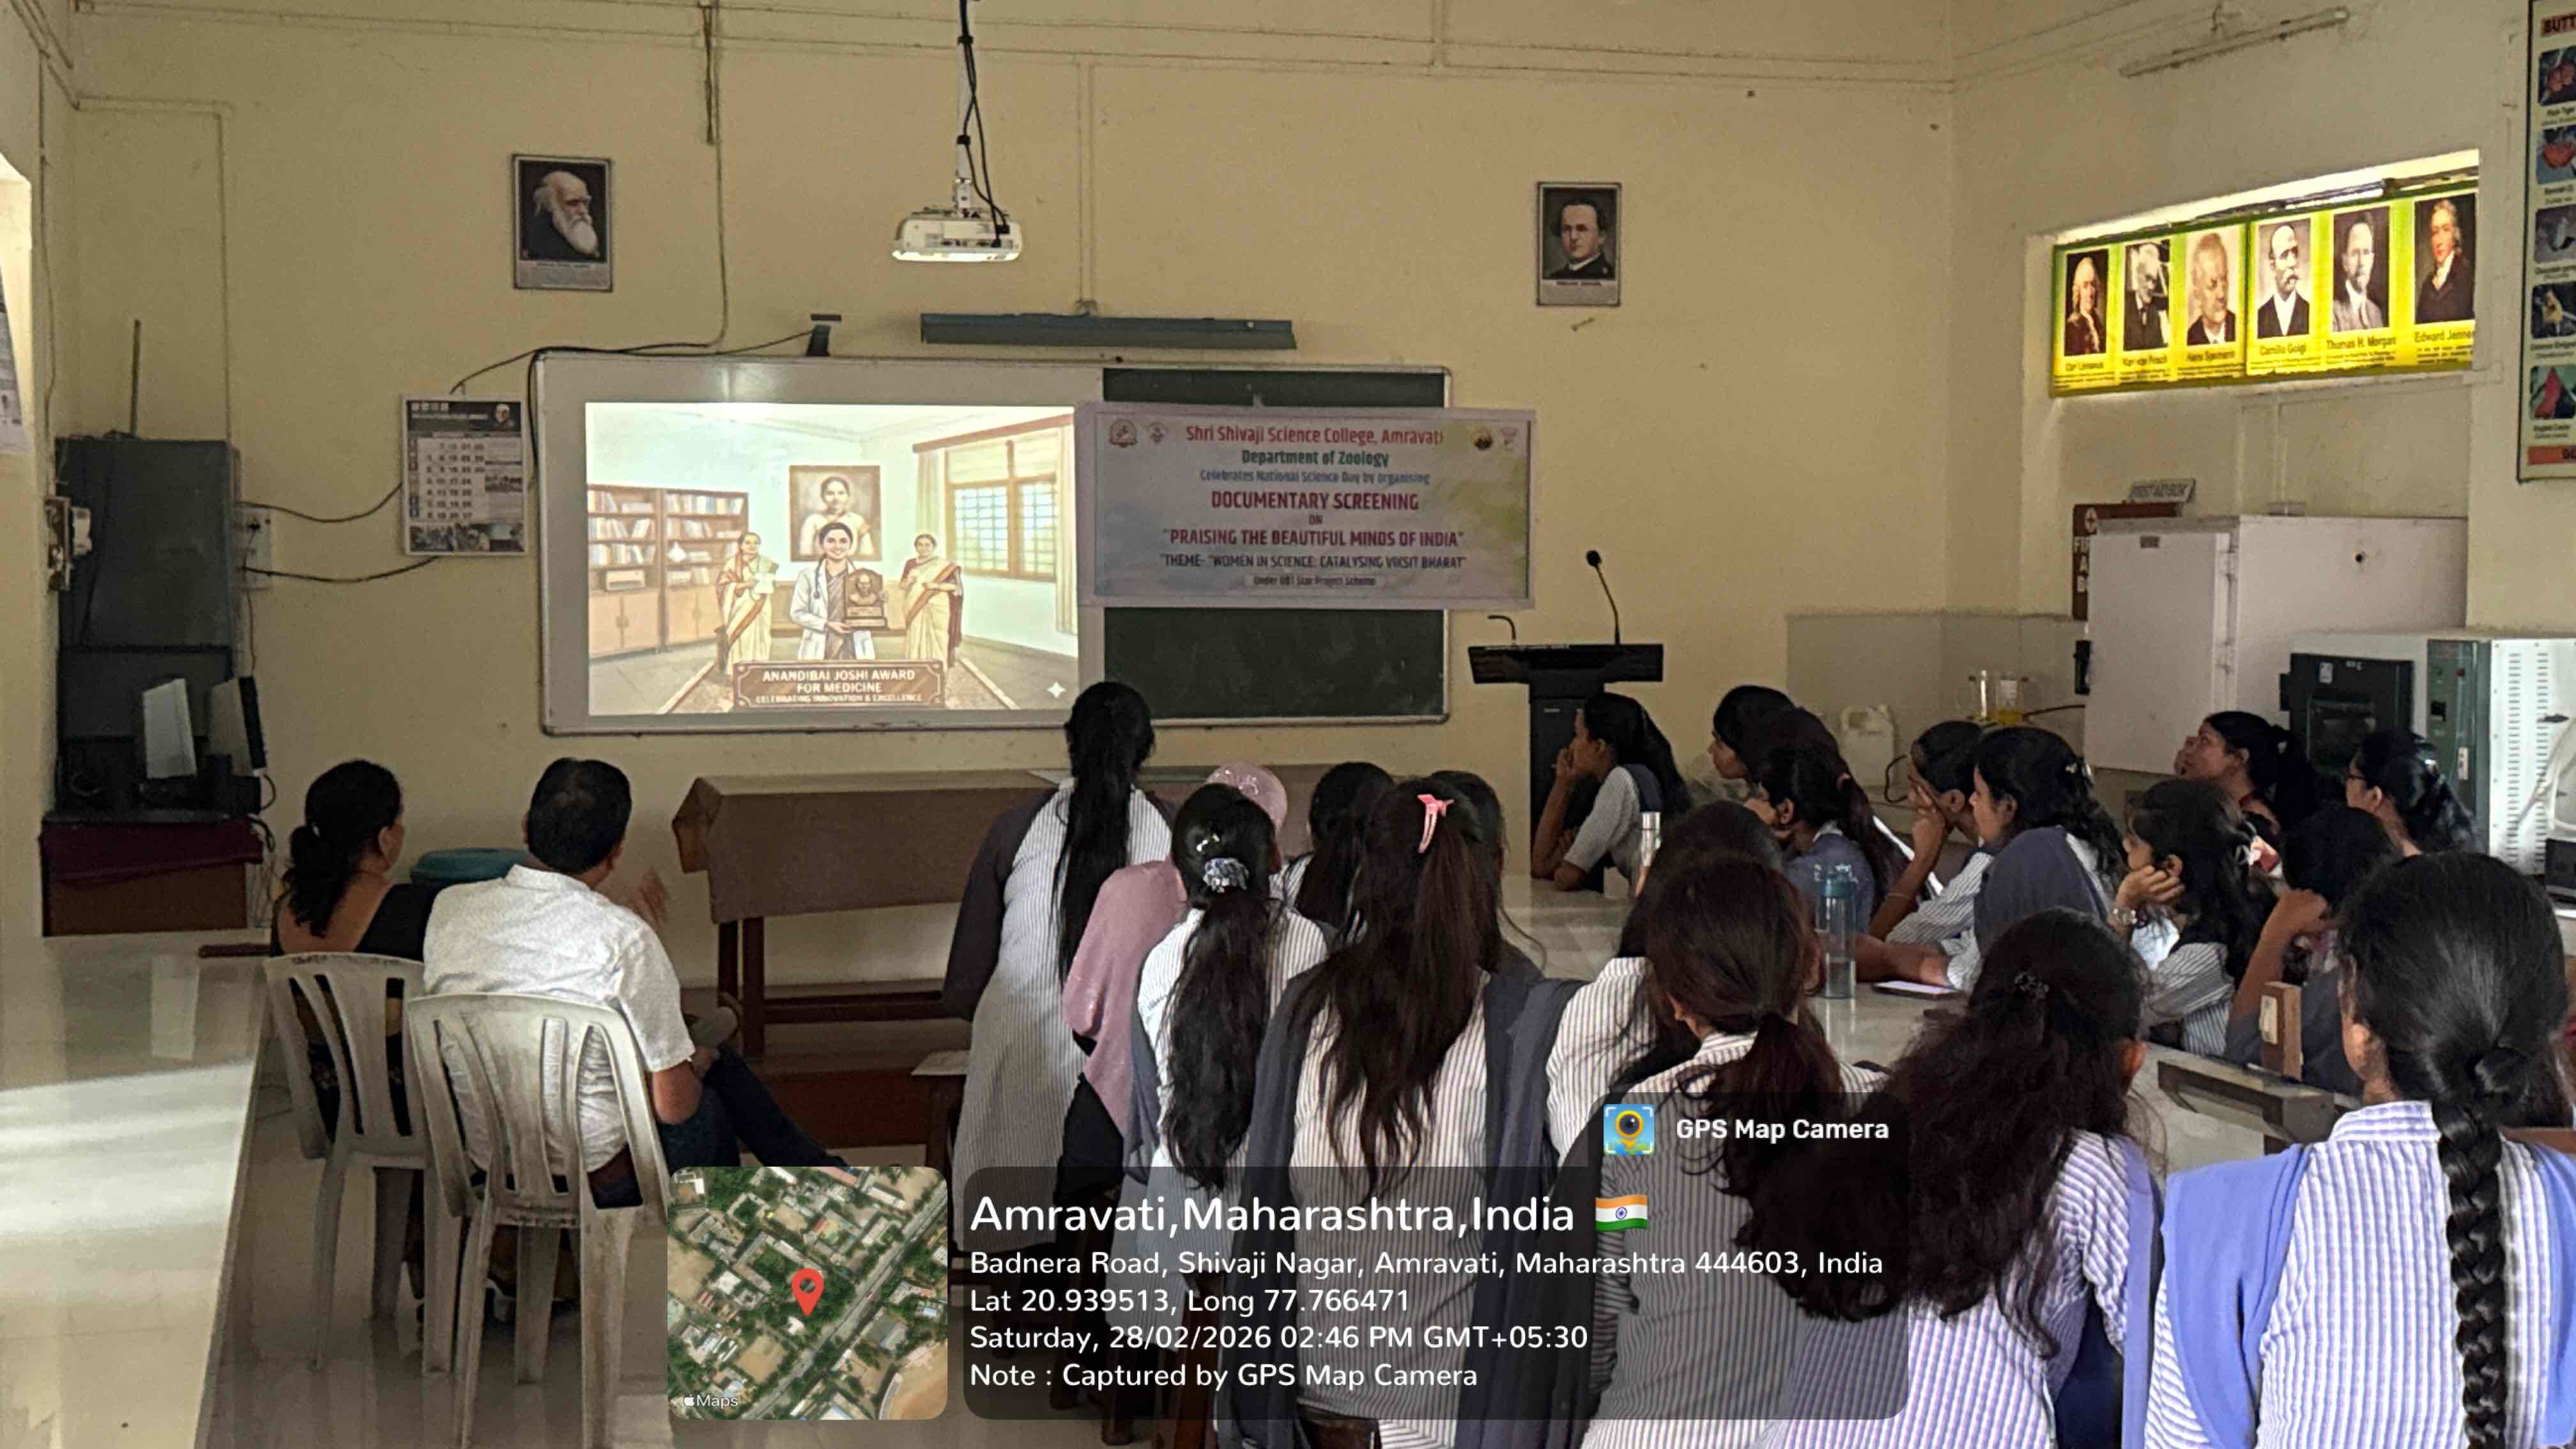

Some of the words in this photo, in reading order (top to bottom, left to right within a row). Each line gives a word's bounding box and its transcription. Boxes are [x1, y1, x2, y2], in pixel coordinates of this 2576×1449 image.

[2414, 331, 2444, 342] Edward
[2327, 339, 2356, 349] Thomas
[1186, 425, 1213, 441] Shri
[1217, 425, 1264, 445] Shivaji
[1268, 426, 1321, 443] Science
[1324, 427, 1378, 446] College,
[1381, 429, 1444, 446] Amravati
[1242, 449, 1319, 466] Department
[1322, 450, 1335, 465] of
[1338, 451, 1390, 468] Zoology
[1211, 491, 1329, 510] DOCUMENTARY
[1333, 492, 1419, 511] SCREENING
[1241, 530, 1268, 545] THE
[1271, 530, 1346, 546] BEAUTIFUL
[1349, 531, 1395, 547] MINDS
[1399, 532, 1416, 547] OF
[1257, 555, 1268, 567] IN
[1320, 556, 1383, 568] CATALYSING
[763, 670, 830, 682] ANANDIBAI
[834, 670, 868, 681] JOSHI
[871, 670, 916, 680] AWARD
[797, 682, 821, 693] FOR
[824, 682, 882, 693] MEDICINE
